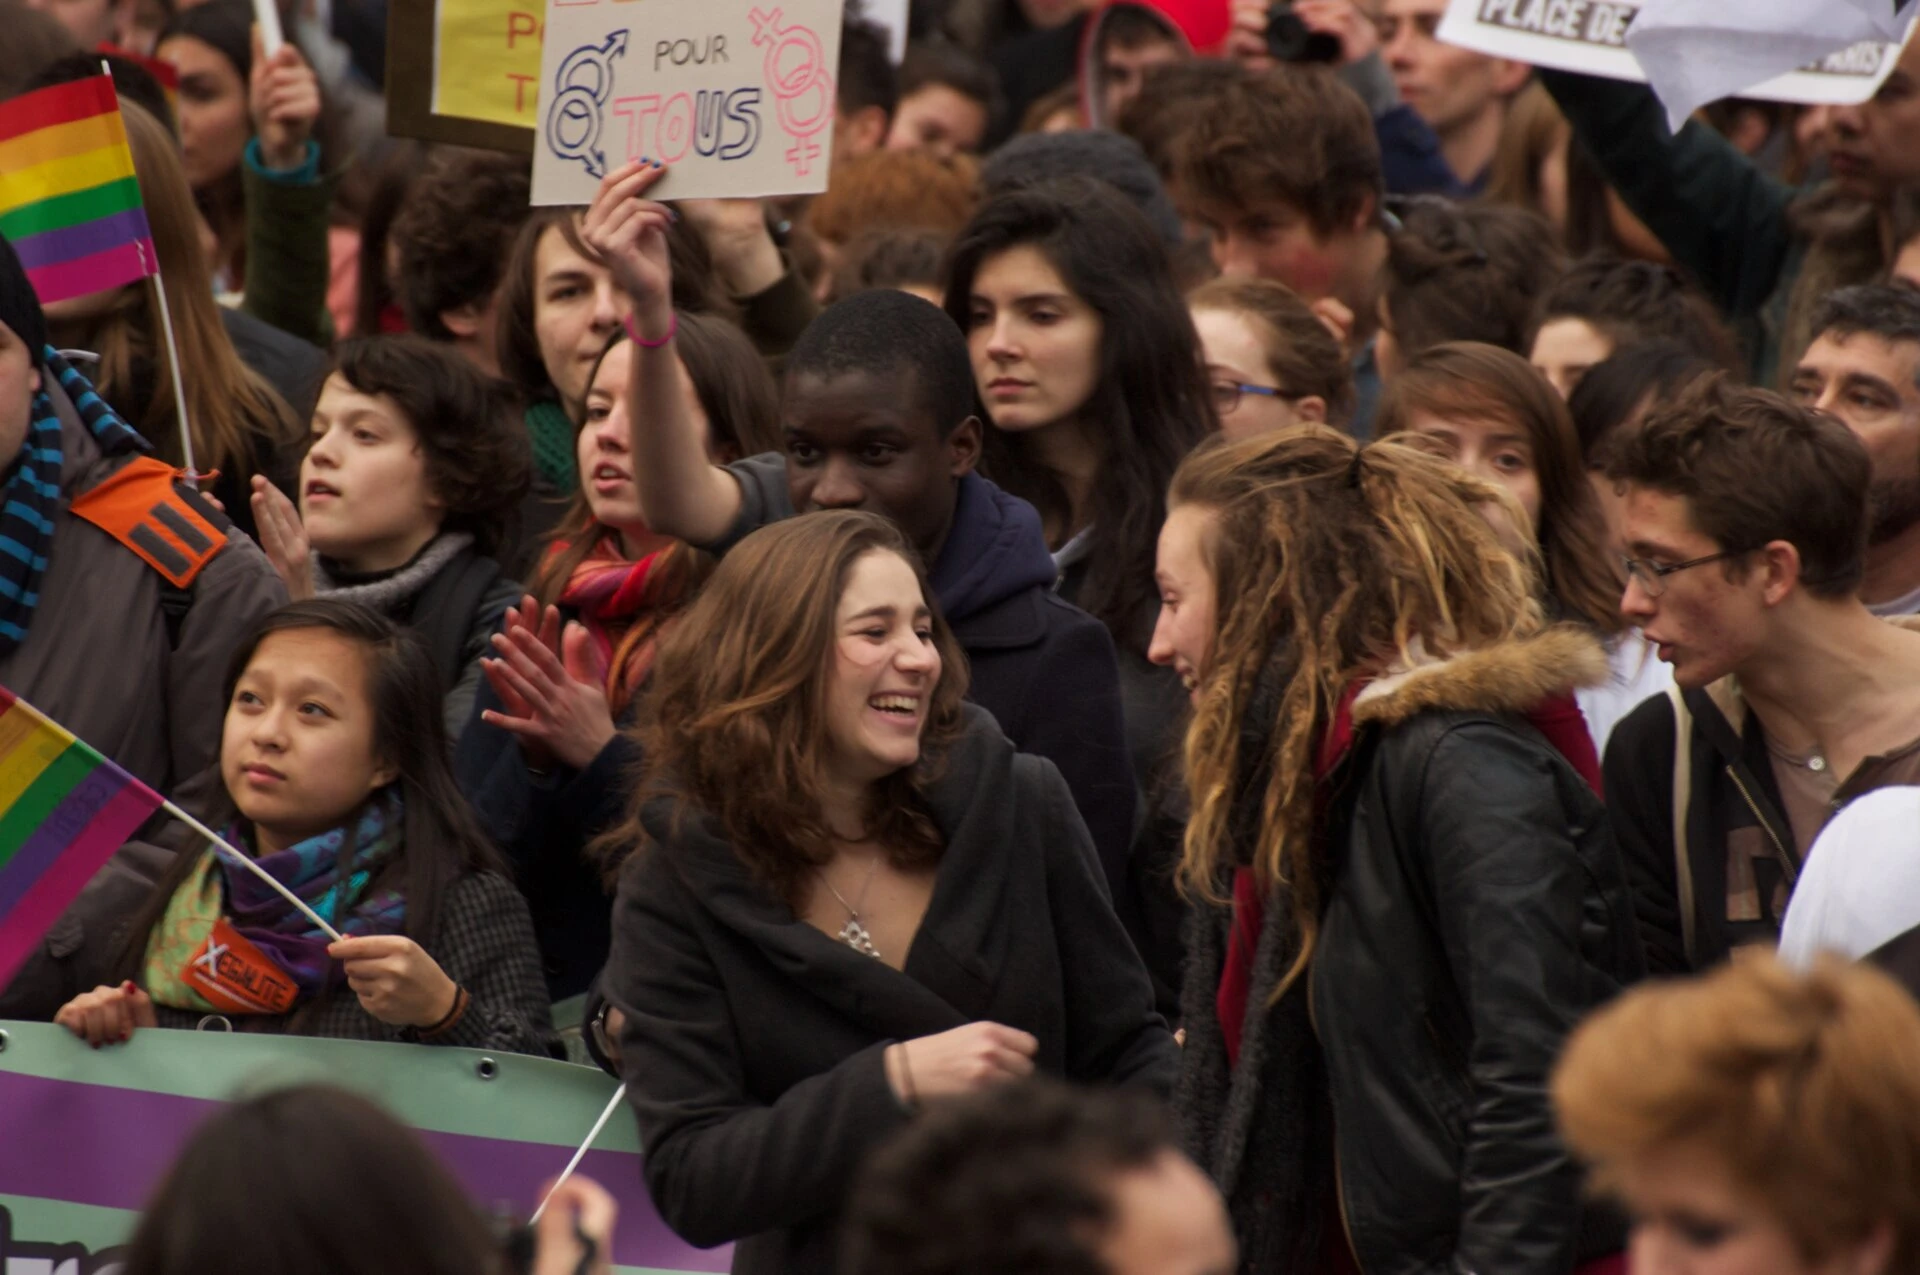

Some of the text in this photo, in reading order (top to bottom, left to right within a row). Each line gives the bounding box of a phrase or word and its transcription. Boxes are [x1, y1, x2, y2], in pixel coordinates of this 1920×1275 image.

[654, 34, 730, 71] POUR
[1484, 0, 1880, 74] PLACE DE ARIS
[613, 87, 762, 164] TOUS
